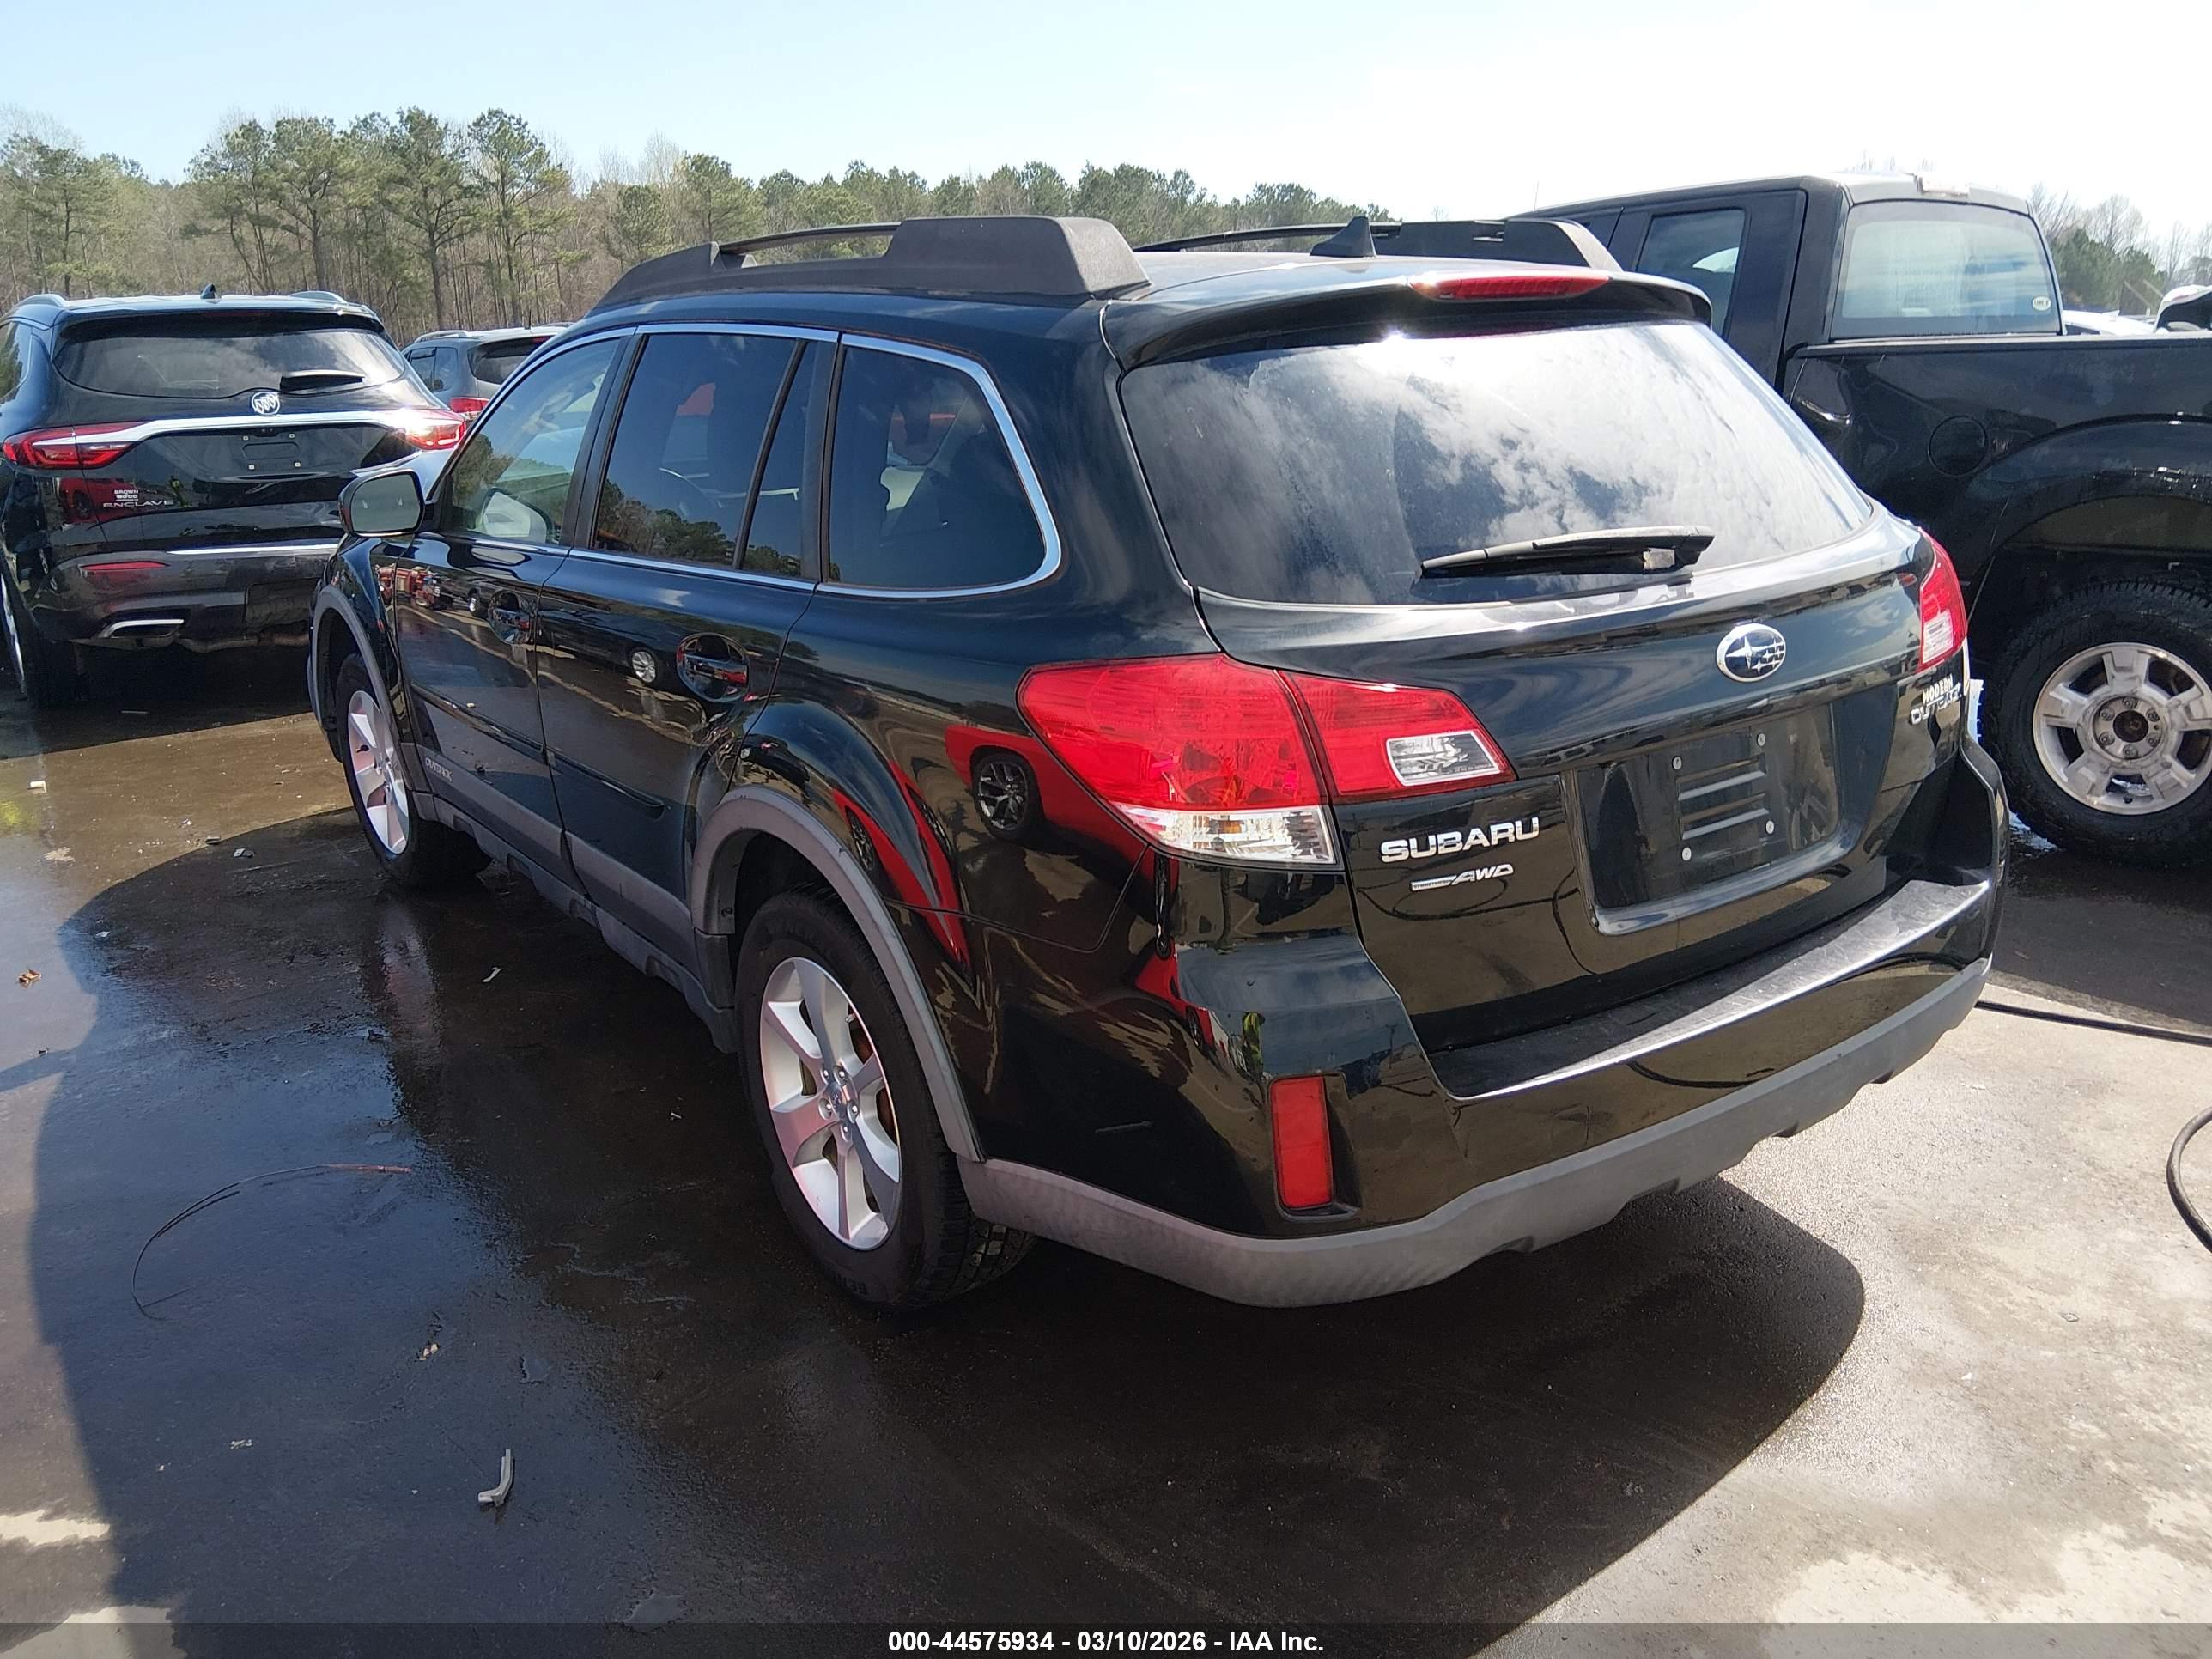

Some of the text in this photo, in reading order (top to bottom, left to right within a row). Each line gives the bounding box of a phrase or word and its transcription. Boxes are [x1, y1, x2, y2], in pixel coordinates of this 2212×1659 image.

[103, 500, 173, 508] ENCLAVE
[1923, 673, 1953, 704] MODERN
[1381, 817, 1540, 863] SUBARU
[1451, 864, 1514, 885] AWD
